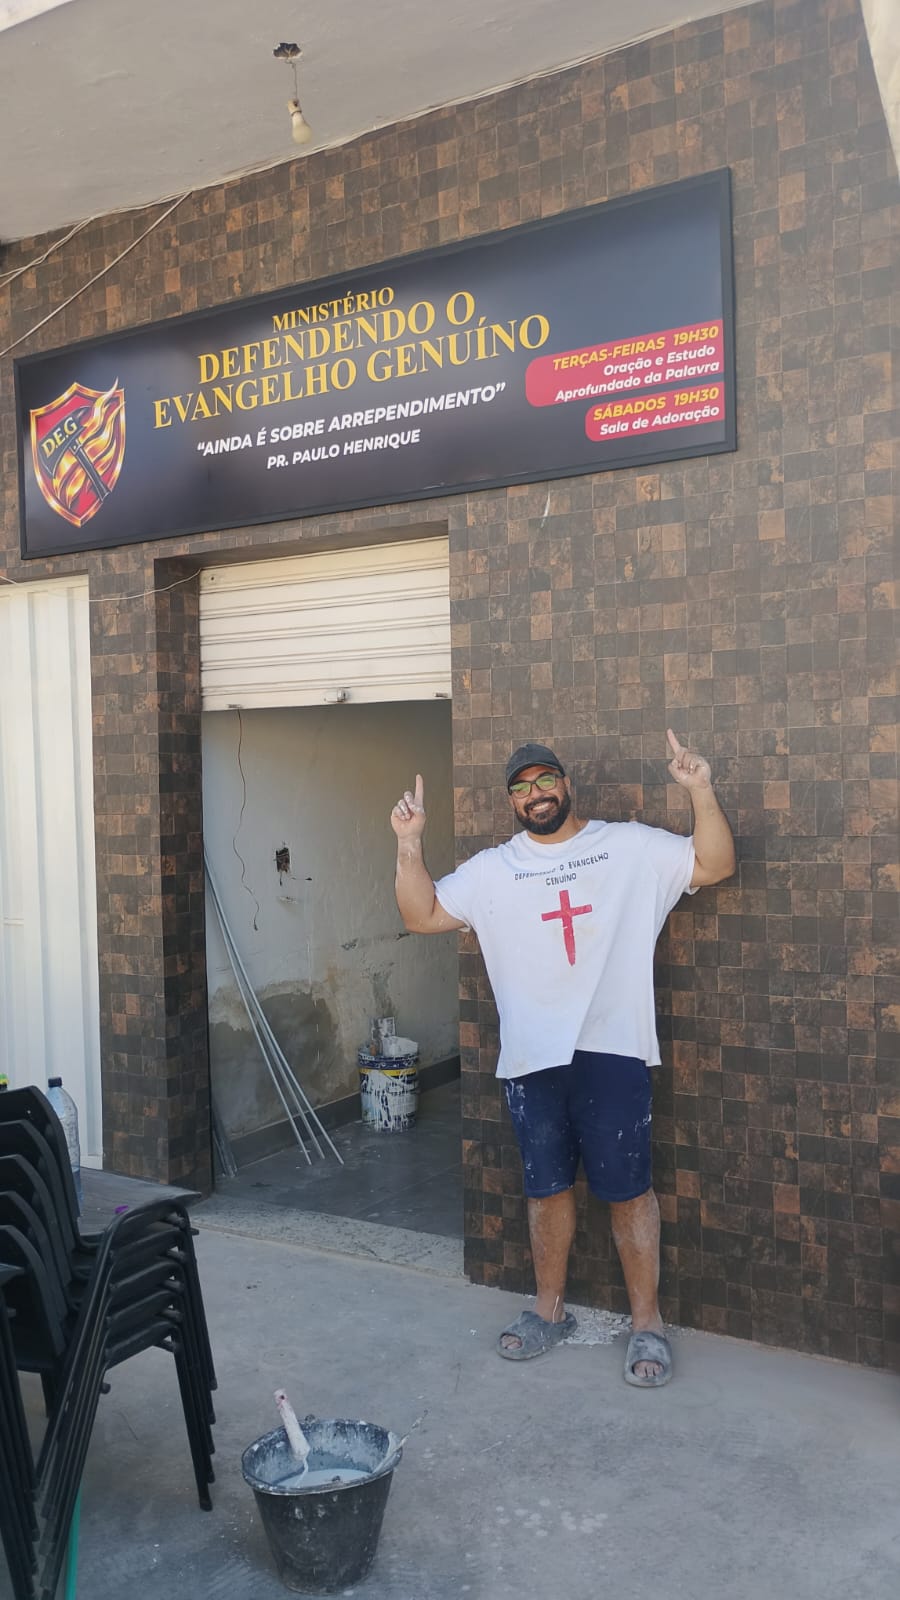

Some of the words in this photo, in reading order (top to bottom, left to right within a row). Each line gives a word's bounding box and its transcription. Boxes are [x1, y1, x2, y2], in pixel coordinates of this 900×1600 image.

[272, 286, 395, 333] MINISTÉRIO
[198, 301, 436, 384] DEFENDENDO
[446, 291, 475, 326] O
[553, 336, 666, 370] TERÇAS-FEIRAS
[673, 325, 719, 345] 19H30
[153, 357, 357, 429] EVANGELHO
[366, 314, 550, 382] GENUÍNO
[555, 376, 641, 402] Aprofundado
[644, 371, 662, 383] da
[665, 360, 720, 381] Palavra
[603, 358, 652, 376] Oração
[655, 356, 664, 366] e
[667, 345, 715, 364] Estudo
[593, 397, 667, 422] SÁBADOS
[674, 387, 719, 406] 19H30
[600, 419, 629, 436] Sala
[632, 417, 649, 429] de
[651, 406, 720, 427] Adoração
[256, 426, 267, 447] É
[270, 419, 325, 444] SOBRE
[267, 454, 289, 470] PR.
[292, 444, 340, 465] PAULO
[343, 429, 421, 457] HENRIQUE
